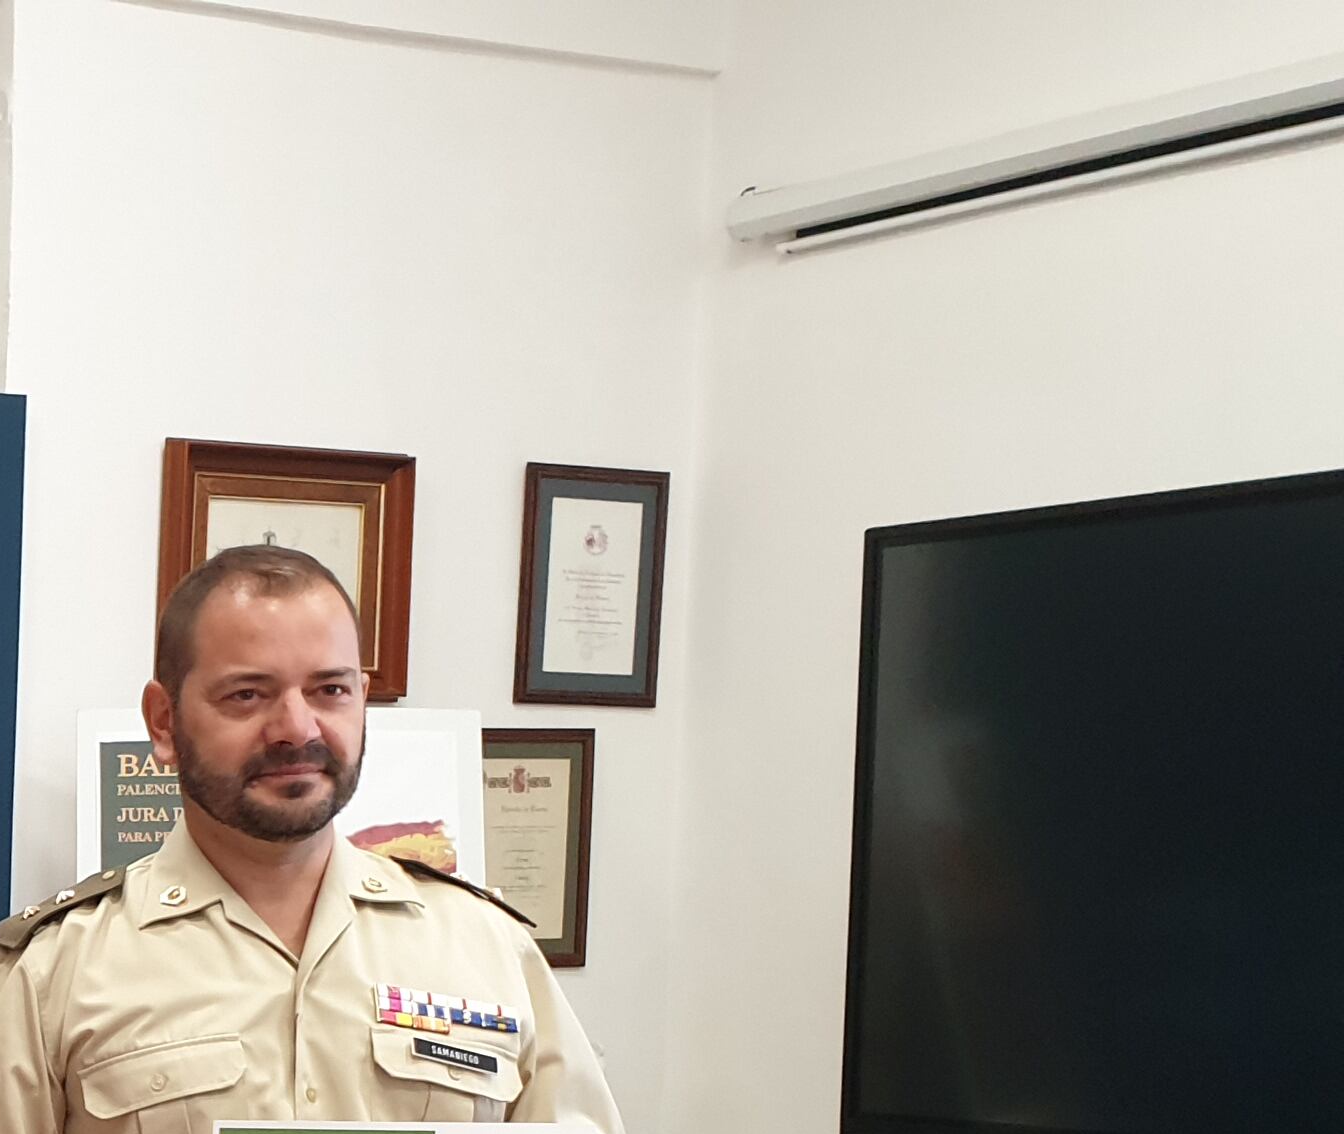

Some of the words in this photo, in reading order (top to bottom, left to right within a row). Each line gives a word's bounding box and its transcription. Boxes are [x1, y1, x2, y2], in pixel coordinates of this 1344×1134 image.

[117, 753, 179, 777] BAL
[117, 783, 182, 796] PALENCI
[117, 807, 169, 822] JURA
[118, 831, 152, 842] PARA
